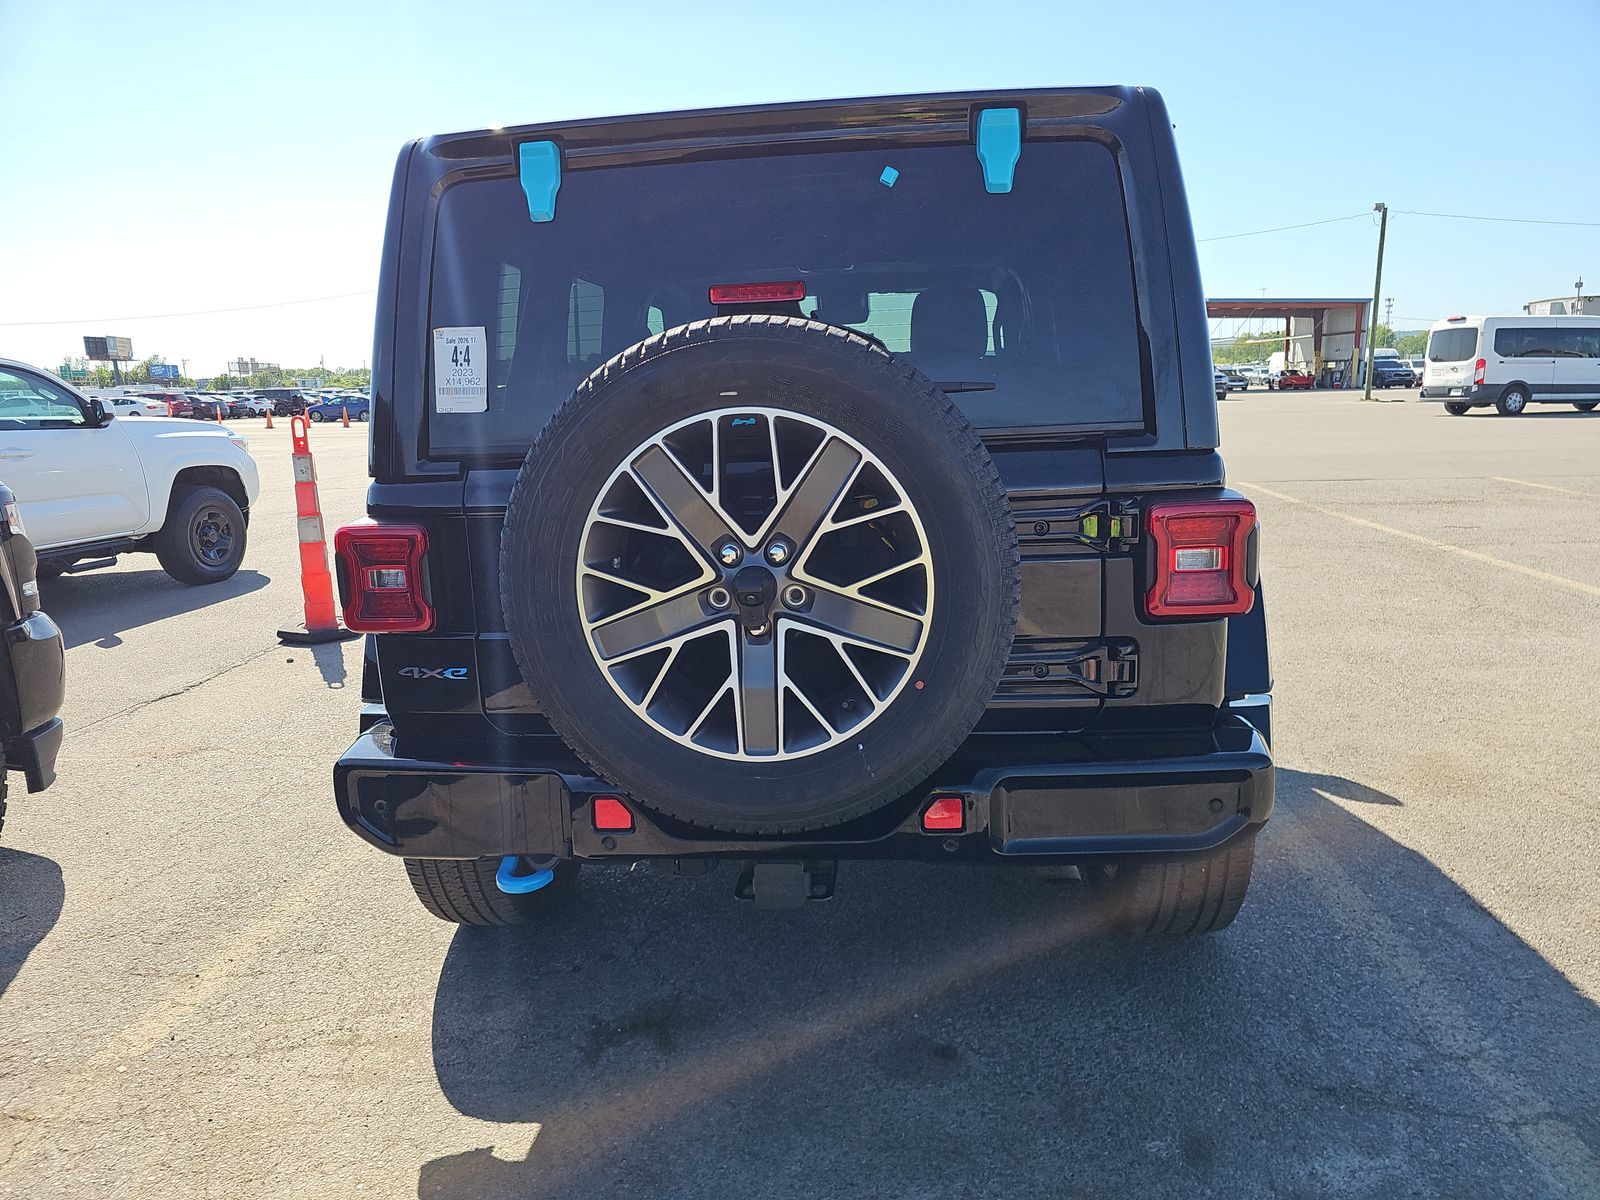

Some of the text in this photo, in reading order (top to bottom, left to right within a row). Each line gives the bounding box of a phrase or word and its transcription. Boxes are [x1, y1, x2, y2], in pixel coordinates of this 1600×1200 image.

[445, 337, 456, 345] Sale
[451, 345, 471, 367] 4:4
[452, 368, 474, 377] 2023
[445, 377, 481, 387] X14,962
